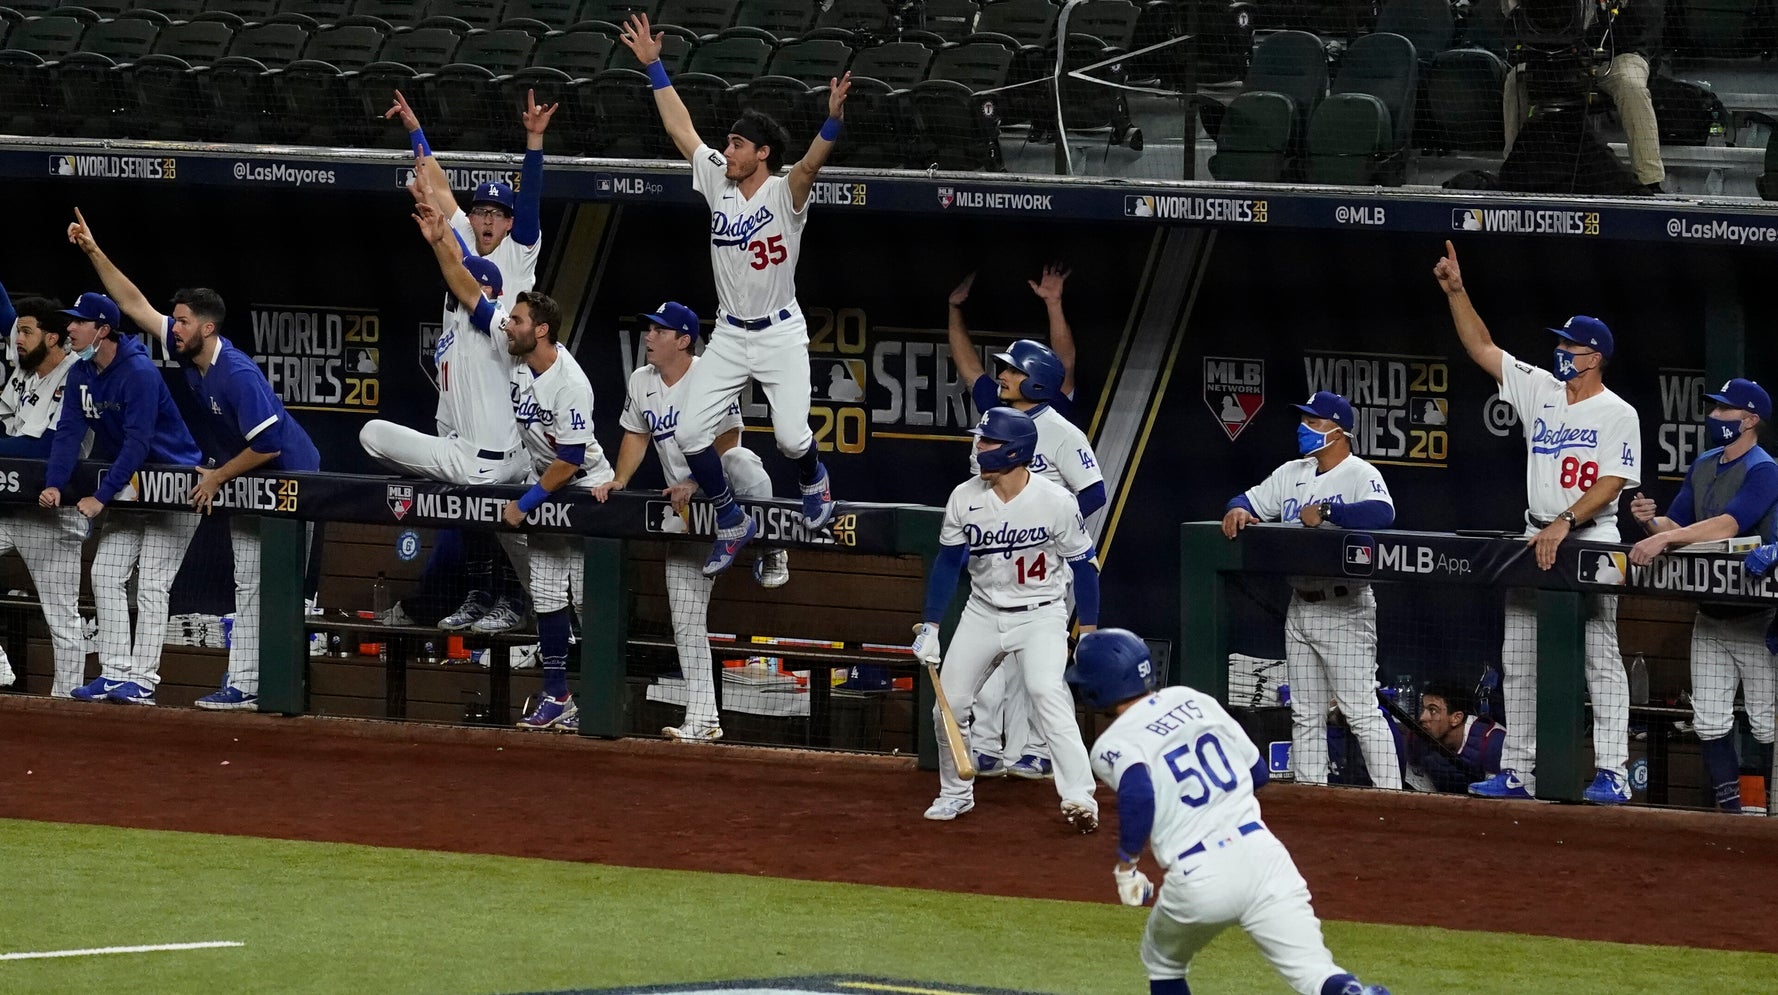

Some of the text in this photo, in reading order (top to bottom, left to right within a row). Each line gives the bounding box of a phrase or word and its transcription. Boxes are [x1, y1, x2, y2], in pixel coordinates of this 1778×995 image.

[77, 155, 120, 178] WORLD
[121, 157, 163, 179] SERIES
[233, 161, 335, 186] @LasMayores
[446, 169, 470, 190] RLD
[613, 178, 663, 194] MLB App
[956, 191, 1053, 210] MLB NETWORK
[1155, 196, 1205, 220] WORLD
[1206, 198, 1252, 222] SERIES
[1335, 205, 1386, 225] @MLB
[1484, 209, 1535, 233] WORLD
[1536, 211, 1584, 235] SERIES
[711, 205, 774, 251] Dodgers
[1667, 218, 1778, 245] @LasMayore
[748, 233, 788, 271] 35
[250, 310, 342, 356] WORLD
[345, 314, 379, 342] 20
[252, 355, 379, 406] ERIES 20
[1206, 360, 1262, 386] MLB
[1303, 356, 1449, 408] WORLD 20
[80, 385, 101, 420] LA
[1206, 384, 1262, 394] NETWORK
[209, 396, 223, 415] LA
[569, 408, 586, 431] LA
[809, 406, 867, 454] 20
[1350, 405, 1449, 460] RIES 20
[1531, 416, 1599, 460] Dodgers
[1721, 425, 1733, 440] LA
[1076, 448, 1096, 470] LA
[1621, 442, 1635, 468] LA
[141, 470, 199, 504] WORL
[1560, 456, 1599, 493] 88
[389, 486, 412, 497] MLB
[416, 493, 572, 527] MLB NETORK
[963, 521, 1050, 560] Dodgers
[1015, 551, 1047, 585] 14
[1378, 543, 1470, 575] MLB App
[1630, 555, 1710, 593] WORLD
[1138, 659, 1151, 678] 50
[1146, 699, 1204, 737] BETTS
[1163, 732, 1238, 809] 50
